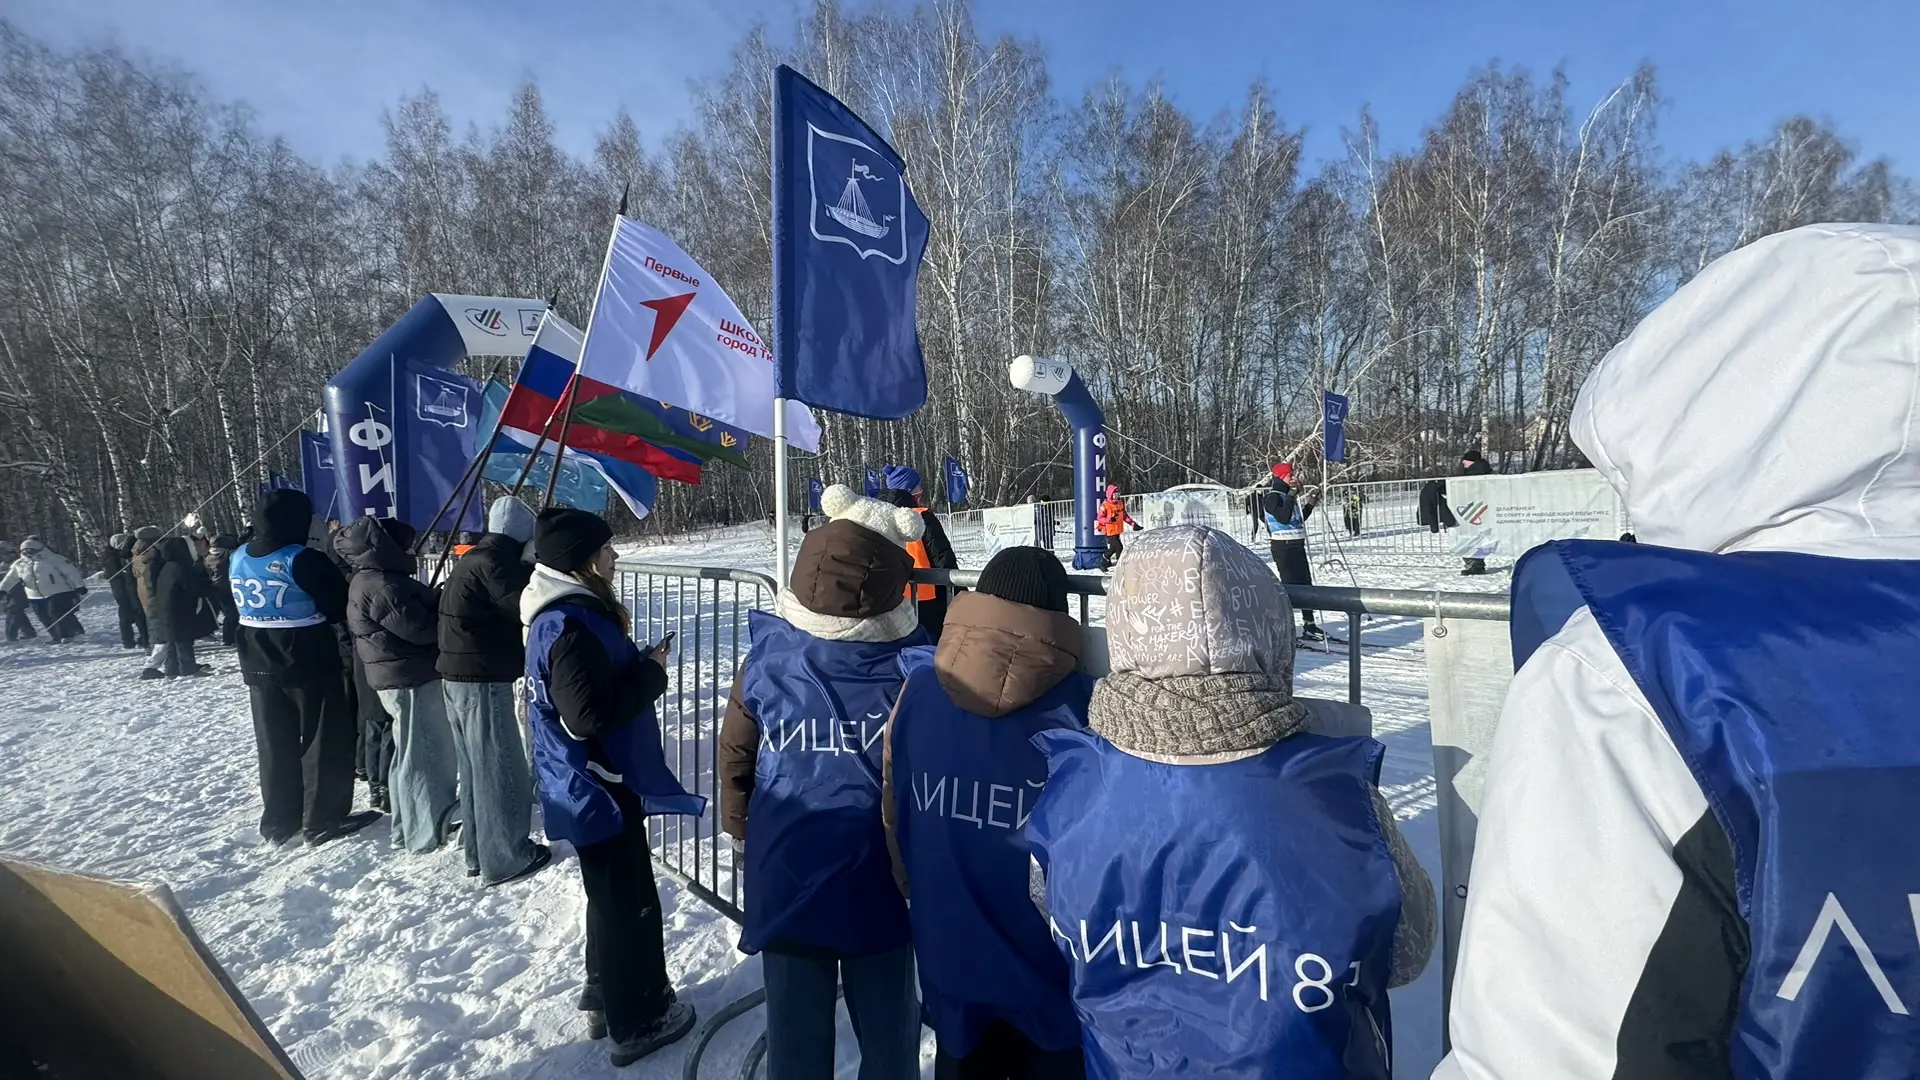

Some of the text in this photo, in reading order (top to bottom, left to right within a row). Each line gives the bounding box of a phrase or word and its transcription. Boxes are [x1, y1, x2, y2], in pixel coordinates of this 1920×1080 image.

[644, 256, 700, 287] Первые
[717, 333, 757, 357] город
[349, 418, 397, 518] ФИ
[562, 469, 579, 484] 72
[1093, 432, 1107, 536] ФИН
[230, 578, 289, 608] 537
[1231, 585, 1259, 611] BUT
[1049, 916, 1268, 1001] ЛИЦЕЙ
